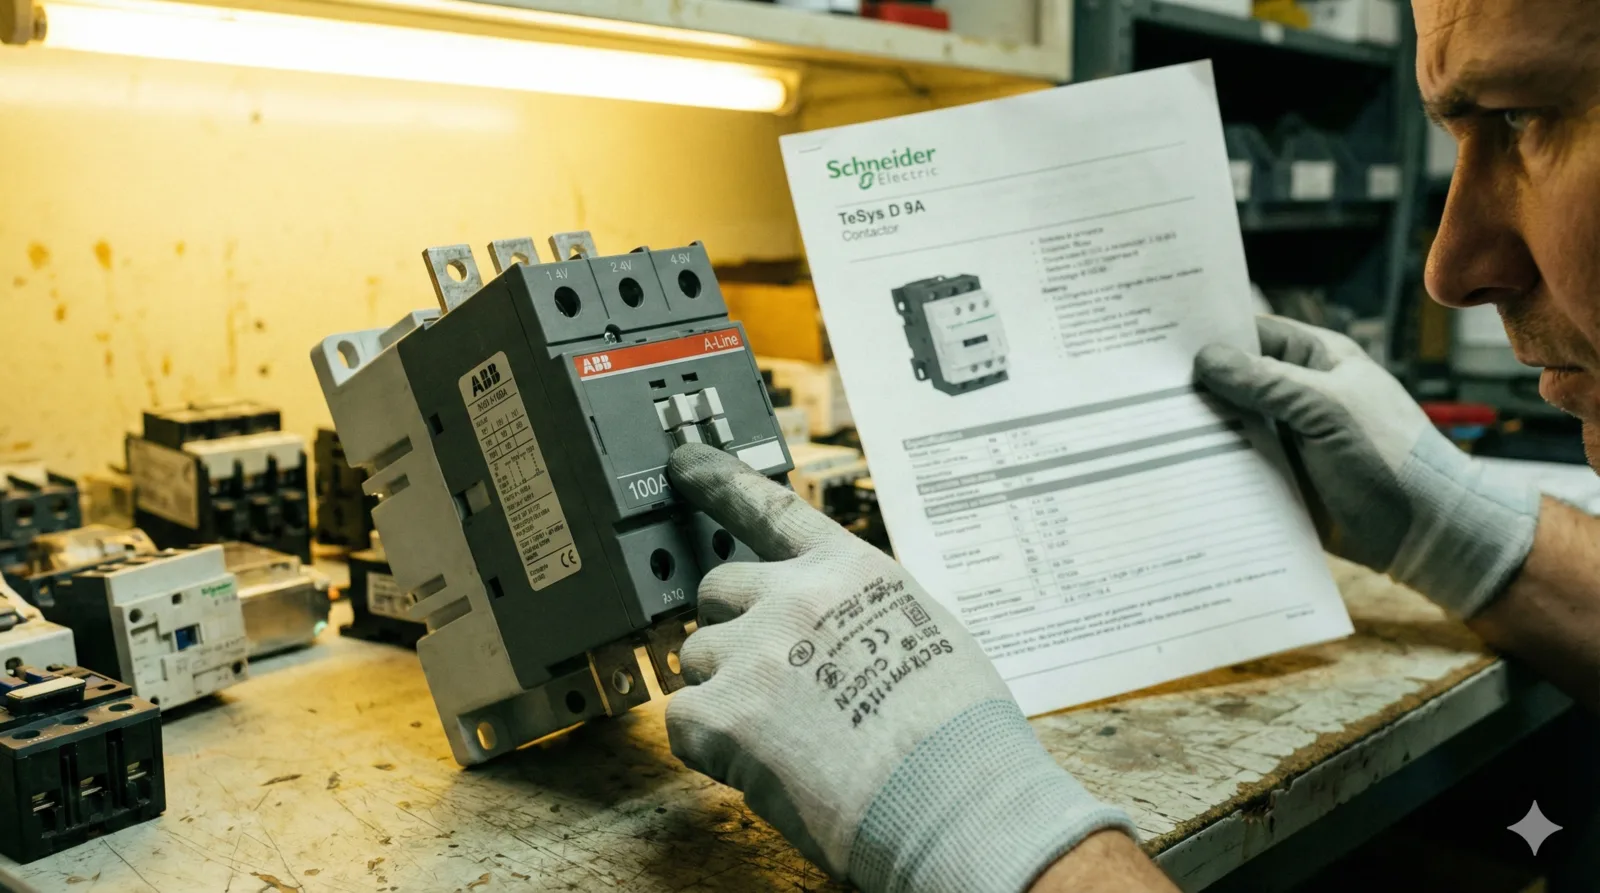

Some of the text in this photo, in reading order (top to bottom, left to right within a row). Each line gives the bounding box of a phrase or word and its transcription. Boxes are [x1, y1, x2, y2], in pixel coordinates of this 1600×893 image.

[826, 147, 936, 179] Schneider
[877, 167, 939, 186] Electric
[838, 199, 926, 225] TeSys D 9A
[842, 224, 899, 242] Contactor
[583, 334, 739, 374] ABB A-Line
[471, 363, 501, 397] ABB
[628, 473, 672, 500] 100A
